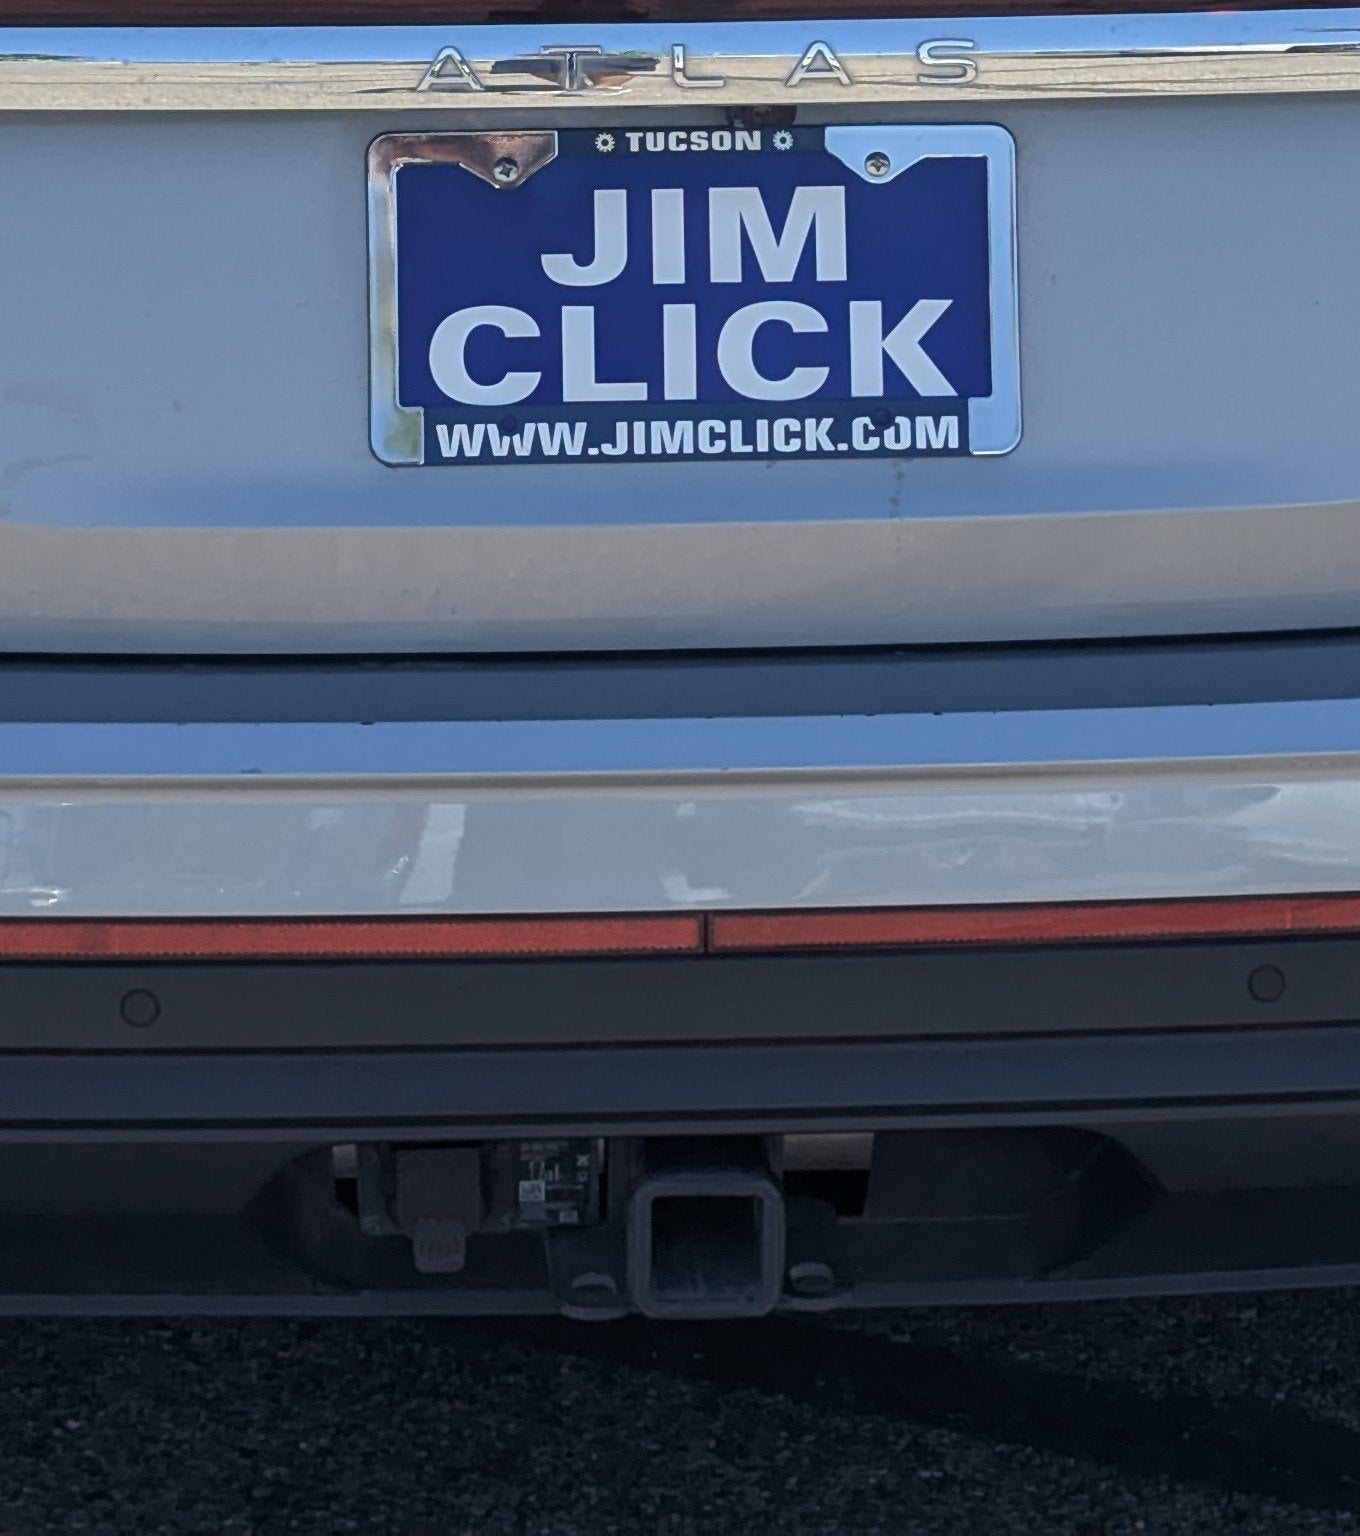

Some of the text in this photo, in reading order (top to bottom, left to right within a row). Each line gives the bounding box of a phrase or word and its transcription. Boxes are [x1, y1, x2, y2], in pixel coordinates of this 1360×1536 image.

[416, 38, 979, 91] ATLAS
[624, 129, 762, 153] TUCSON
[540, 185, 848, 288] JIM
[428, 298, 959, 406] CLICK
[435, 414, 960, 458] WWW.JIMCLICK.COM
